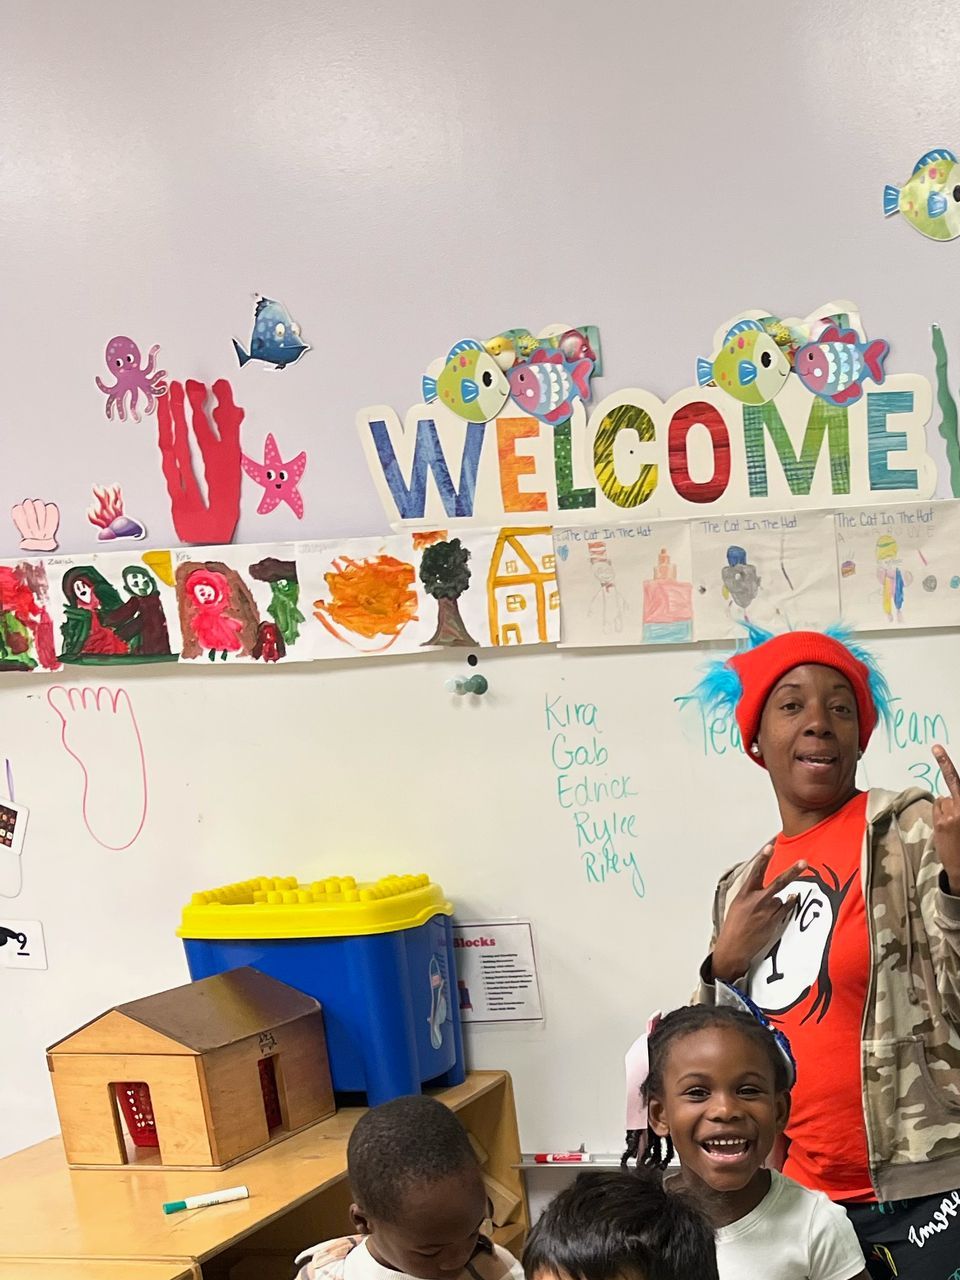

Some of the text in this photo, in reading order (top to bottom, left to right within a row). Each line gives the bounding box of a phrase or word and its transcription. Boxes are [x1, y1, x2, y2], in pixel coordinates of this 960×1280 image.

[368, 392, 919, 519] WELCOME
[564, 526, 652, 541] The Cat In The Hat
[700, 517, 798, 534] The Cat In The Hat
[836, 508, 935, 528] The Cat In The Hat
[545, 693, 603, 733] Kira
[673, 695, 747, 756] Tea
[551, 733, 609, 771] Gab
[557, 772, 638, 808] Edrick
[573, 811, 640, 852] Rylee
[453, 936, 496, 948] Blocks
